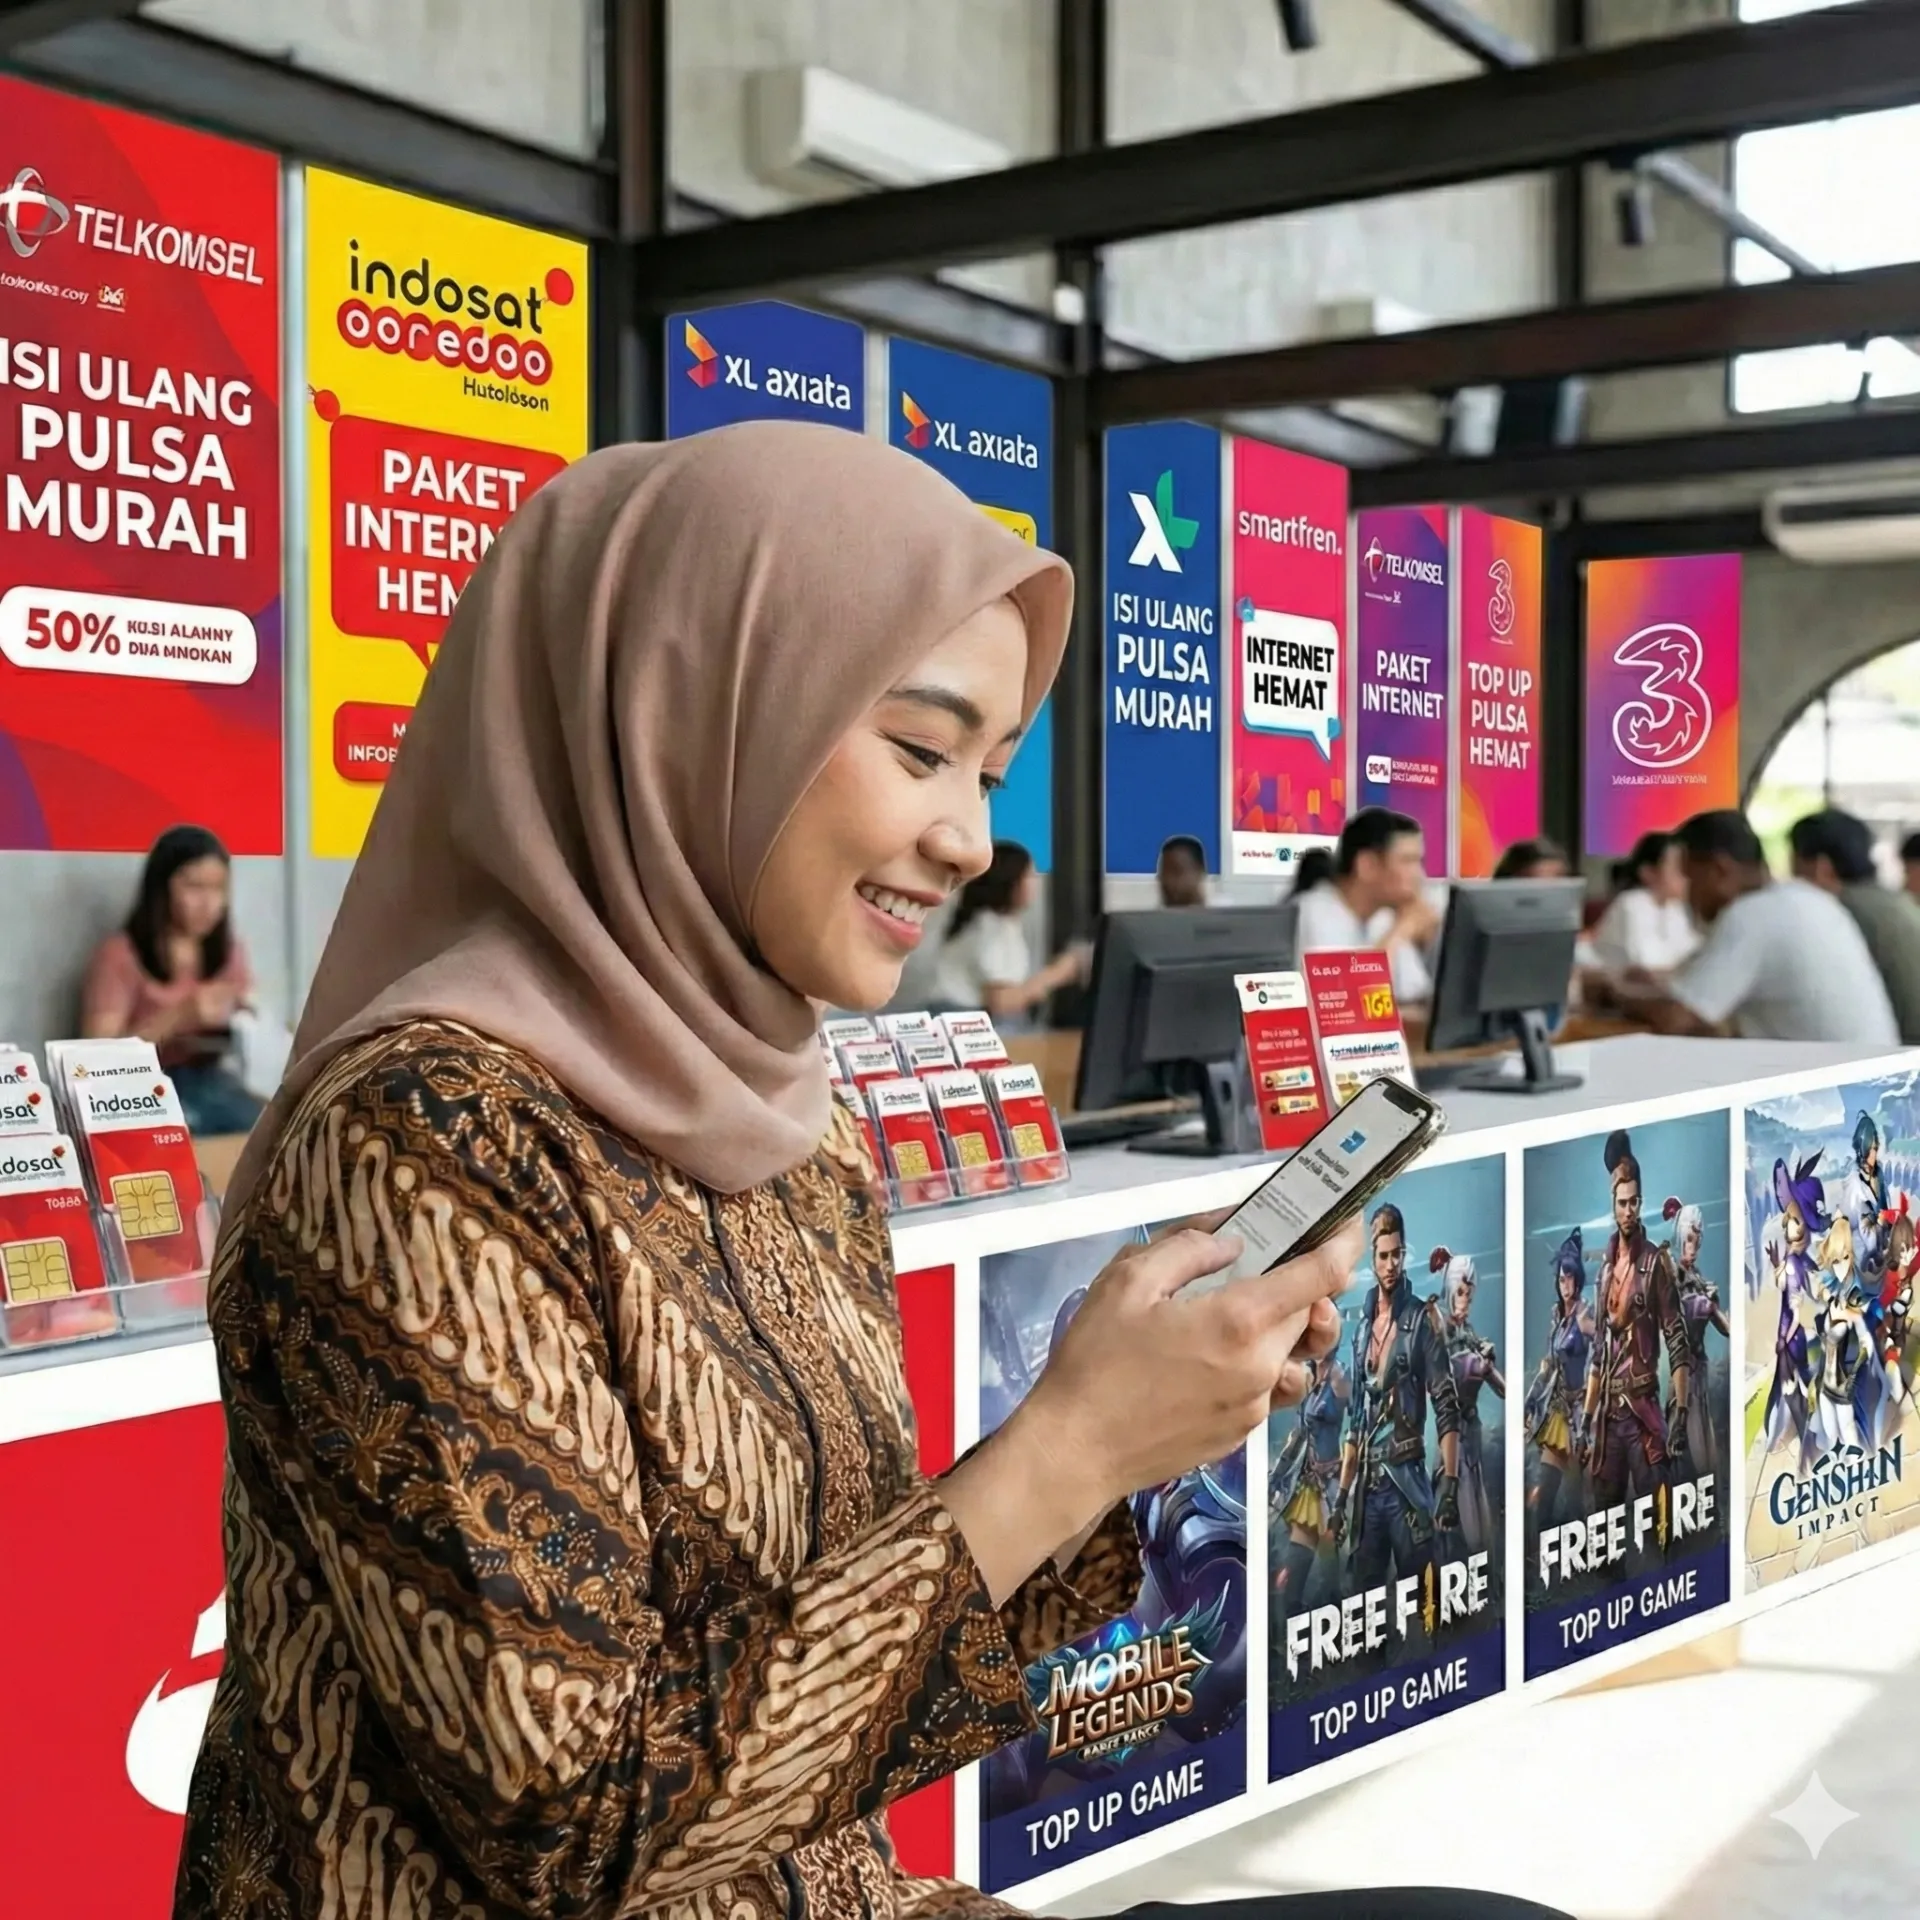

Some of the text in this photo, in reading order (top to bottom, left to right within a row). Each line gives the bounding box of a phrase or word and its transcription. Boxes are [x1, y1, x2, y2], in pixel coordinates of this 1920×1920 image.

[75, 204, 264, 285] TELKOMSEL
[350, 239, 544, 335] indosat
[343, 305, 549, 382] ooredoo
[0, 337, 252, 427] ISI ULANG
[724, 355, 758, 390] XL
[21, 402, 235, 491] PULSA
[934, 420, 962, 452] XL
[384, 449, 526, 512] PAKET
[5, 474, 247, 560] MURAH
[25, 607, 121, 656] 50%
[1113, 592, 1213, 635] ISI ULANG
[1117, 633, 1210, 685] PULSA
[1246, 635, 1334, 674] INTERNET
[1376, 649, 1431, 685] PAKET
[1468, 662, 1532, 698] TOP UP
[1115, 686, 1212, 733] MURAH
[1253, 672, 1327, 712] HEMAT
[1362, 683, 1443, 720] INTERNET
[1472, 701, 1529, 735] PULSA
[1469, 737, 1531, 769] HEMAT
[1539, 1504, 1627, 1590] FREE
[1797, 1496, 1879, 1541] IMPACT
[1286, 1585, 1387, 1682] FREE
[1559, 1569, 1697, 1649] TOP UP GAME
[1044, 1625, 1208, 1714] MOBILE
[1046, 1675, 1194, 1764] LEGENDS
[1309, 1657, 1468, 1745] TOP UP GAME
[1026, 1759, 1204, 1856] TOP UP GAME
